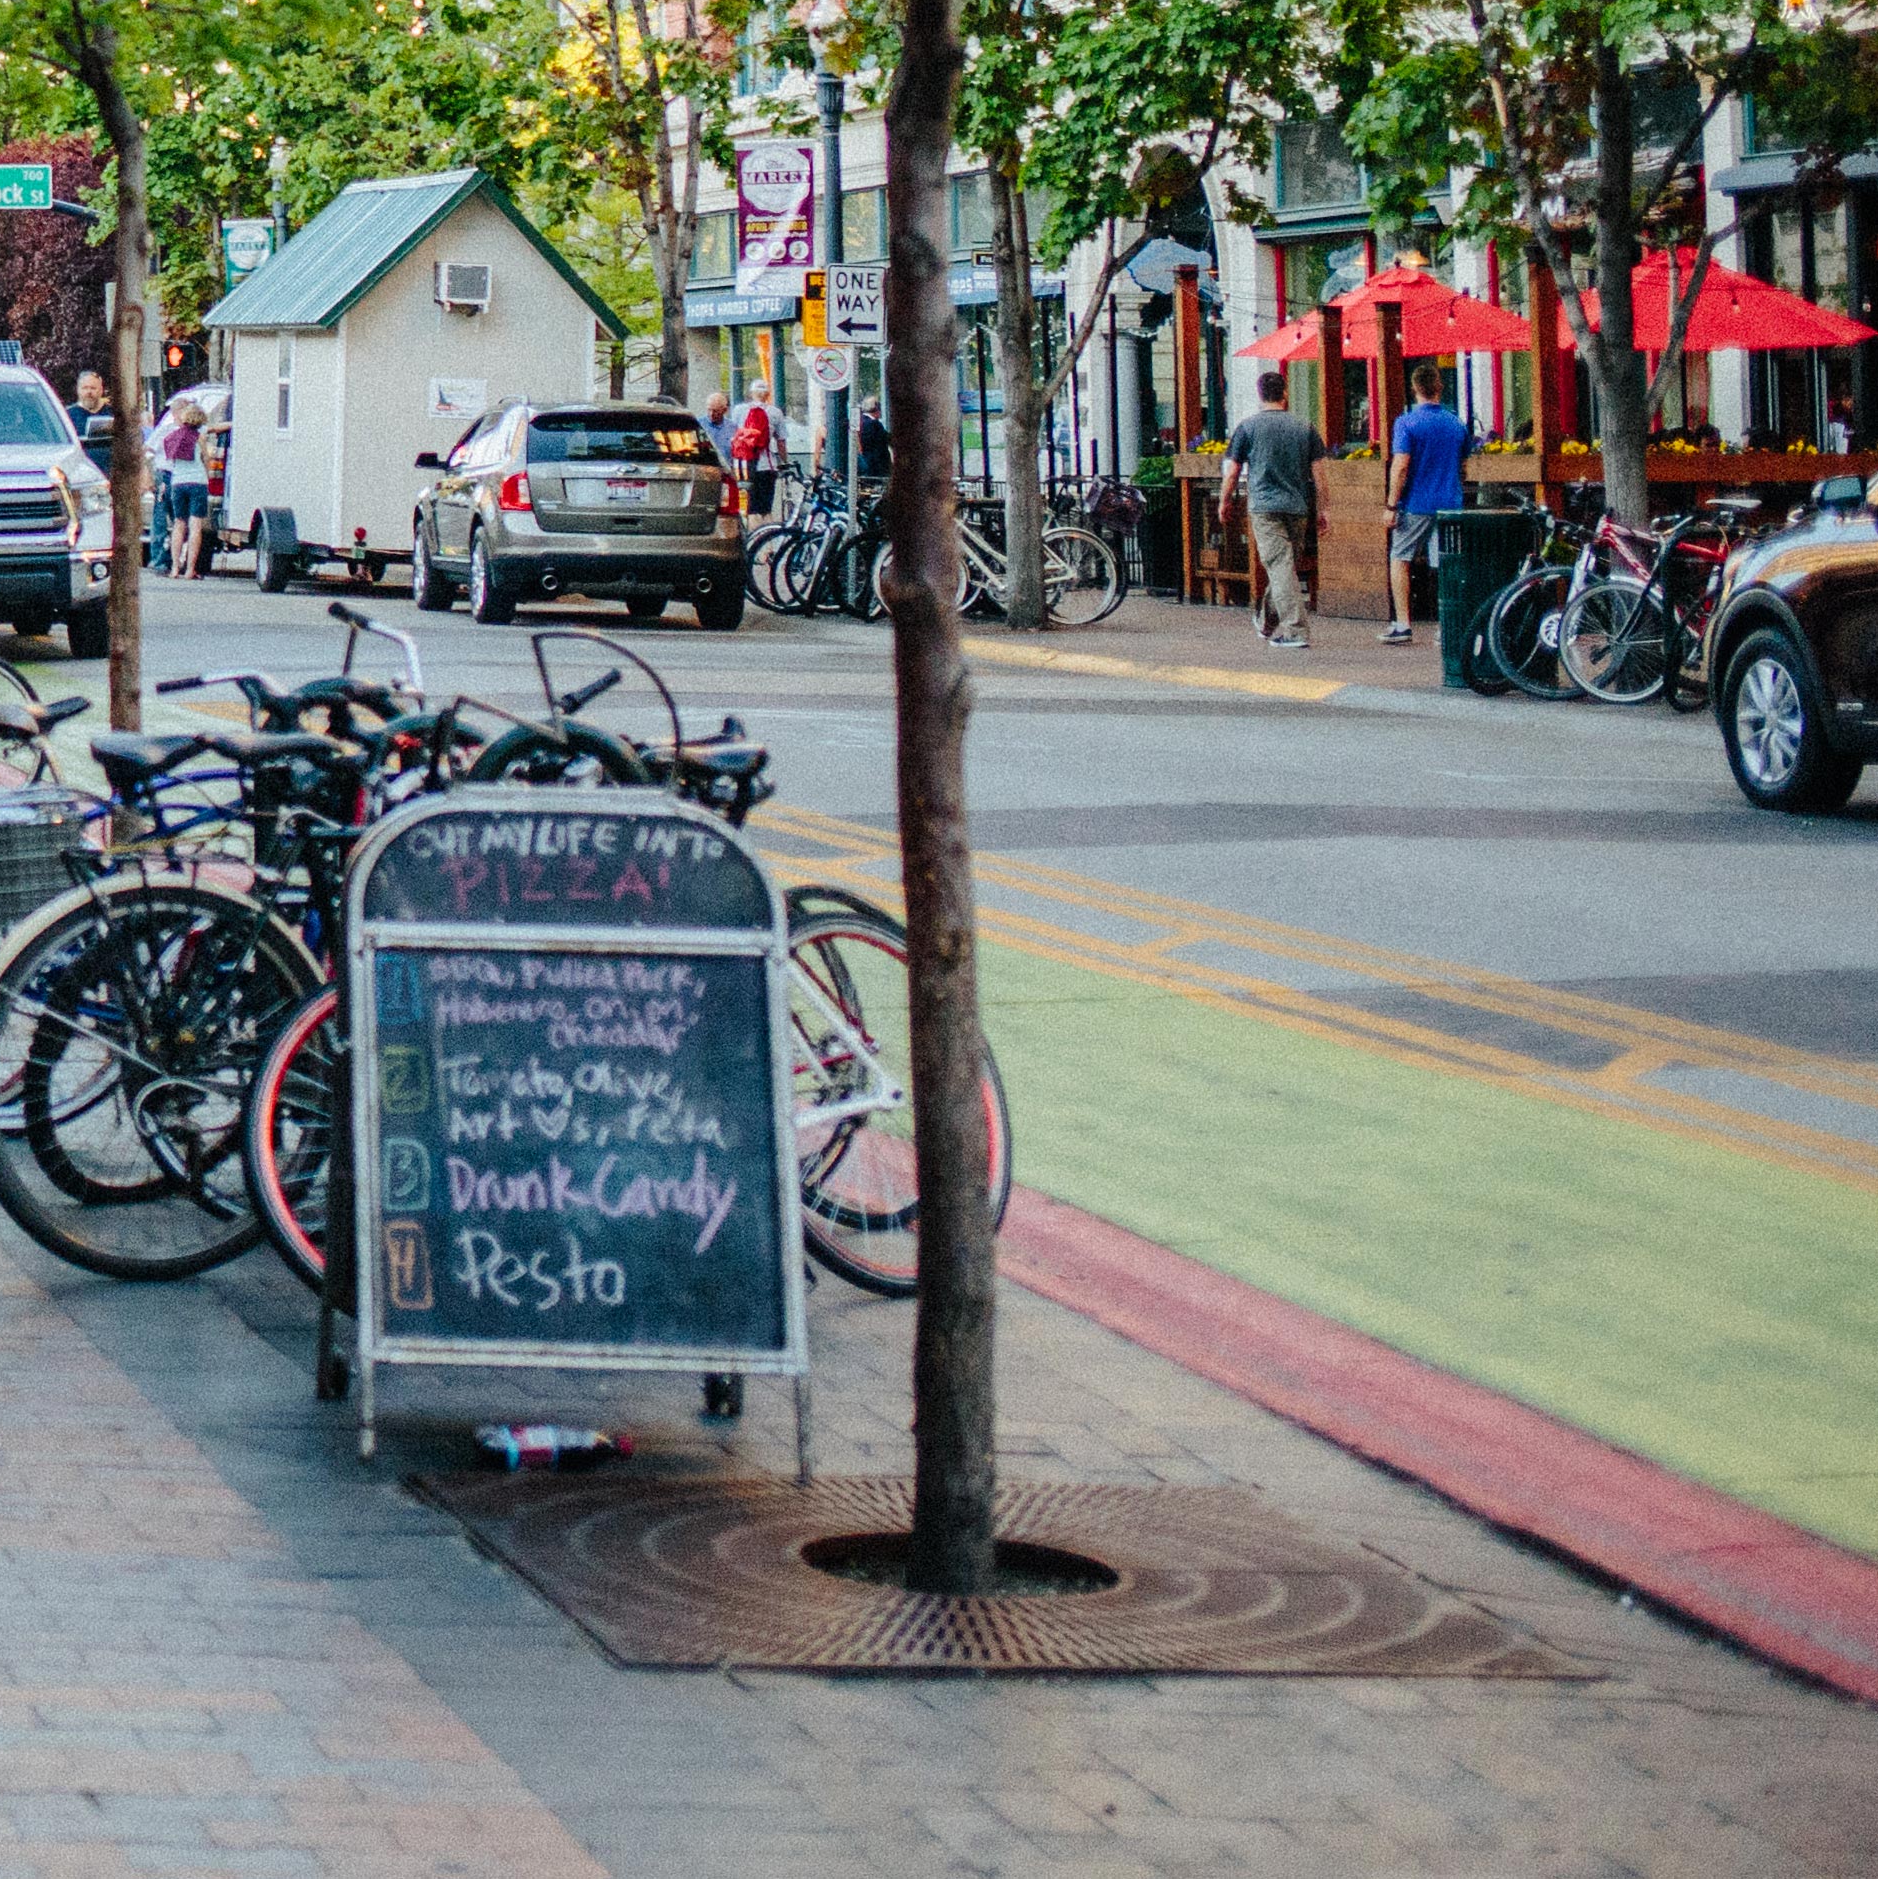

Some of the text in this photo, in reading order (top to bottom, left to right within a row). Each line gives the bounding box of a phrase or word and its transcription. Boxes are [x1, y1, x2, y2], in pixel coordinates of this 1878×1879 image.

[742, 172, 810, 186] MARKET
[31, 189, 45, 204] St
[835, 271, 878, 291] ONE
[836, 294, 879, 312] WAY
[479, 820, 531, 857] MY
[536, 818, 618, 857] LIFE
[446, 1154, 593, 1213] Drunk
[591, 1149, 738, 1255] Candy
[453, 1227, 627, 1311] Pesto
